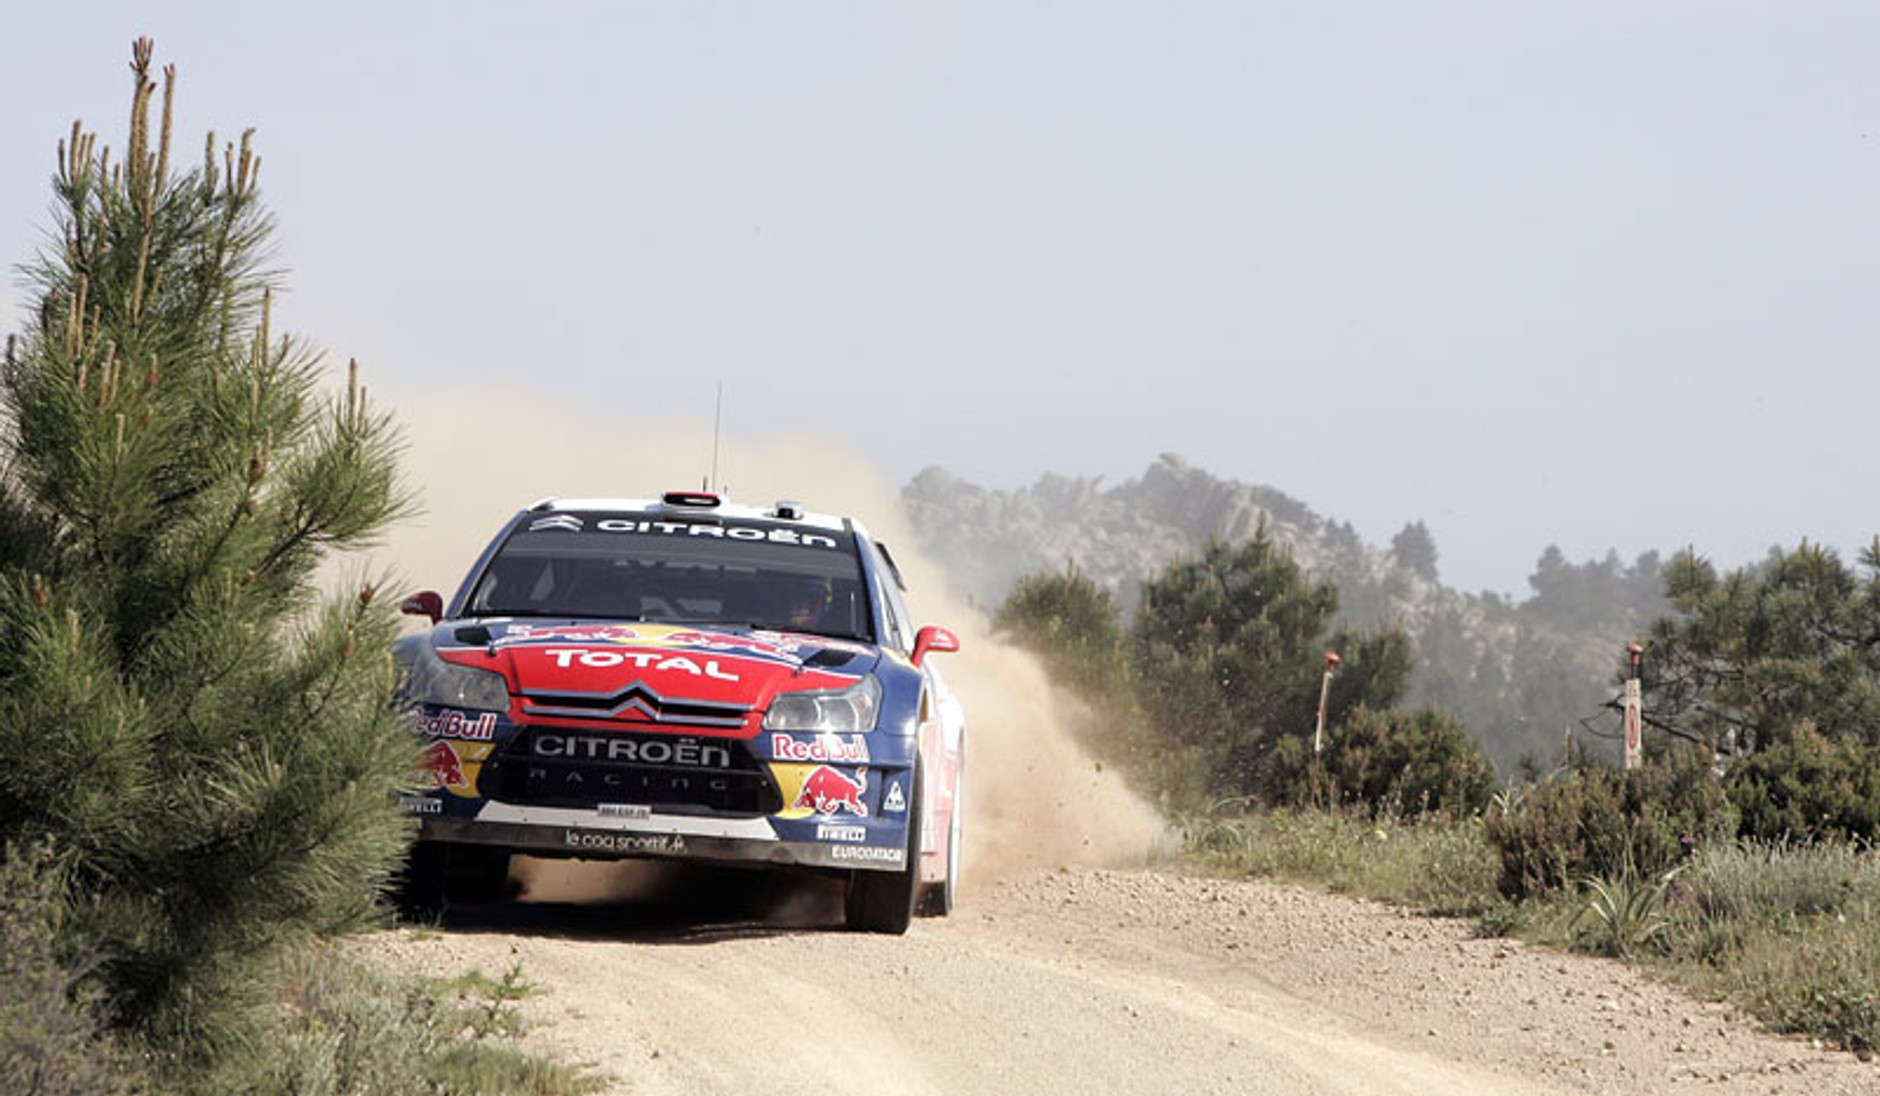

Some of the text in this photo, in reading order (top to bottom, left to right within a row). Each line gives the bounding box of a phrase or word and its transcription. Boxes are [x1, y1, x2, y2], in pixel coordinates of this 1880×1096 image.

[545, 649, 740, 682] TOTAL
[442, 710, 497, 739] Bull
[773, 734, 870, 763] Red Bull
